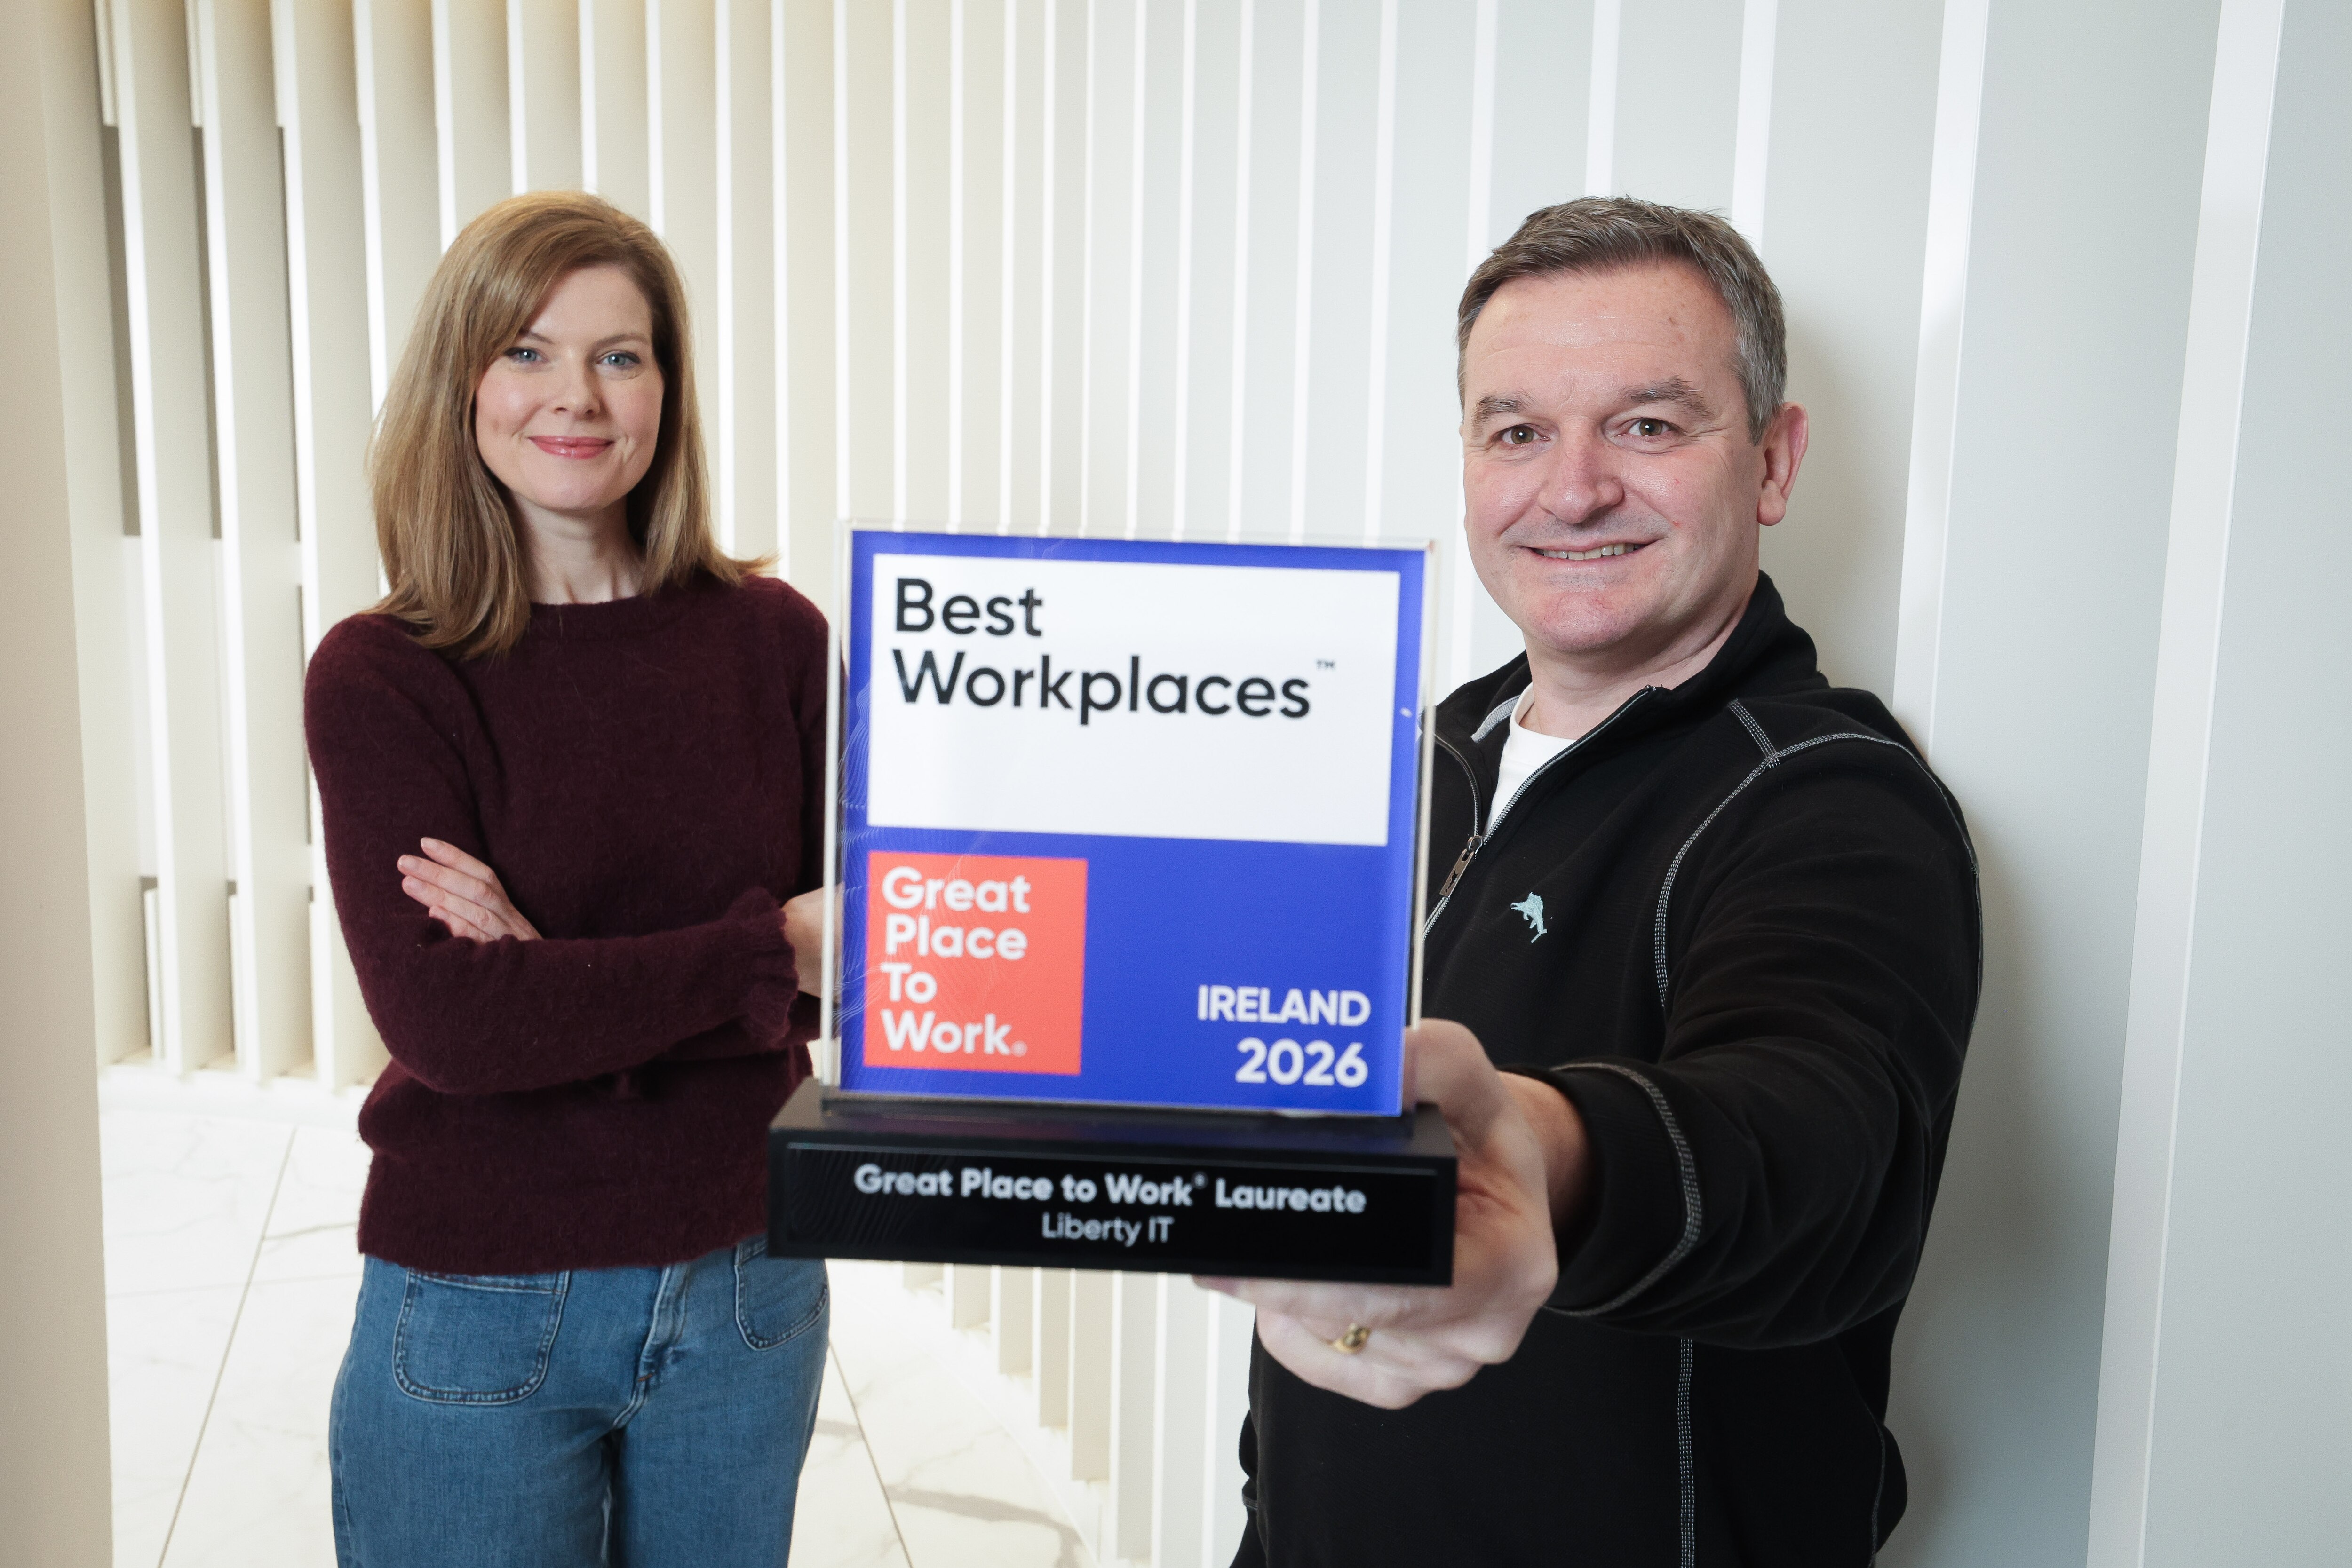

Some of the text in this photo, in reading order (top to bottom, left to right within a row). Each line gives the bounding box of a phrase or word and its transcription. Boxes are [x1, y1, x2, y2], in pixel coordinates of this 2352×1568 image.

[896, 578, 1043, 637] Best
[881, 865, 1031, 914] Great
[884, 915, 1028, 960] Place
[879, 961, 938, 1004] To
[1197, 984, 1371, 1027] IRELAND
[1235, 1037, 1369, 1088] 2026
[854, 1163, 953, 1197] Great
[960, 1167, 1053, 1201] Place
[1061, 1174, 1097, 1202] to
[1215, 1178, 1367, 1213] Laureate
[1041, 1212, 1175, 1247] Liberty IT
